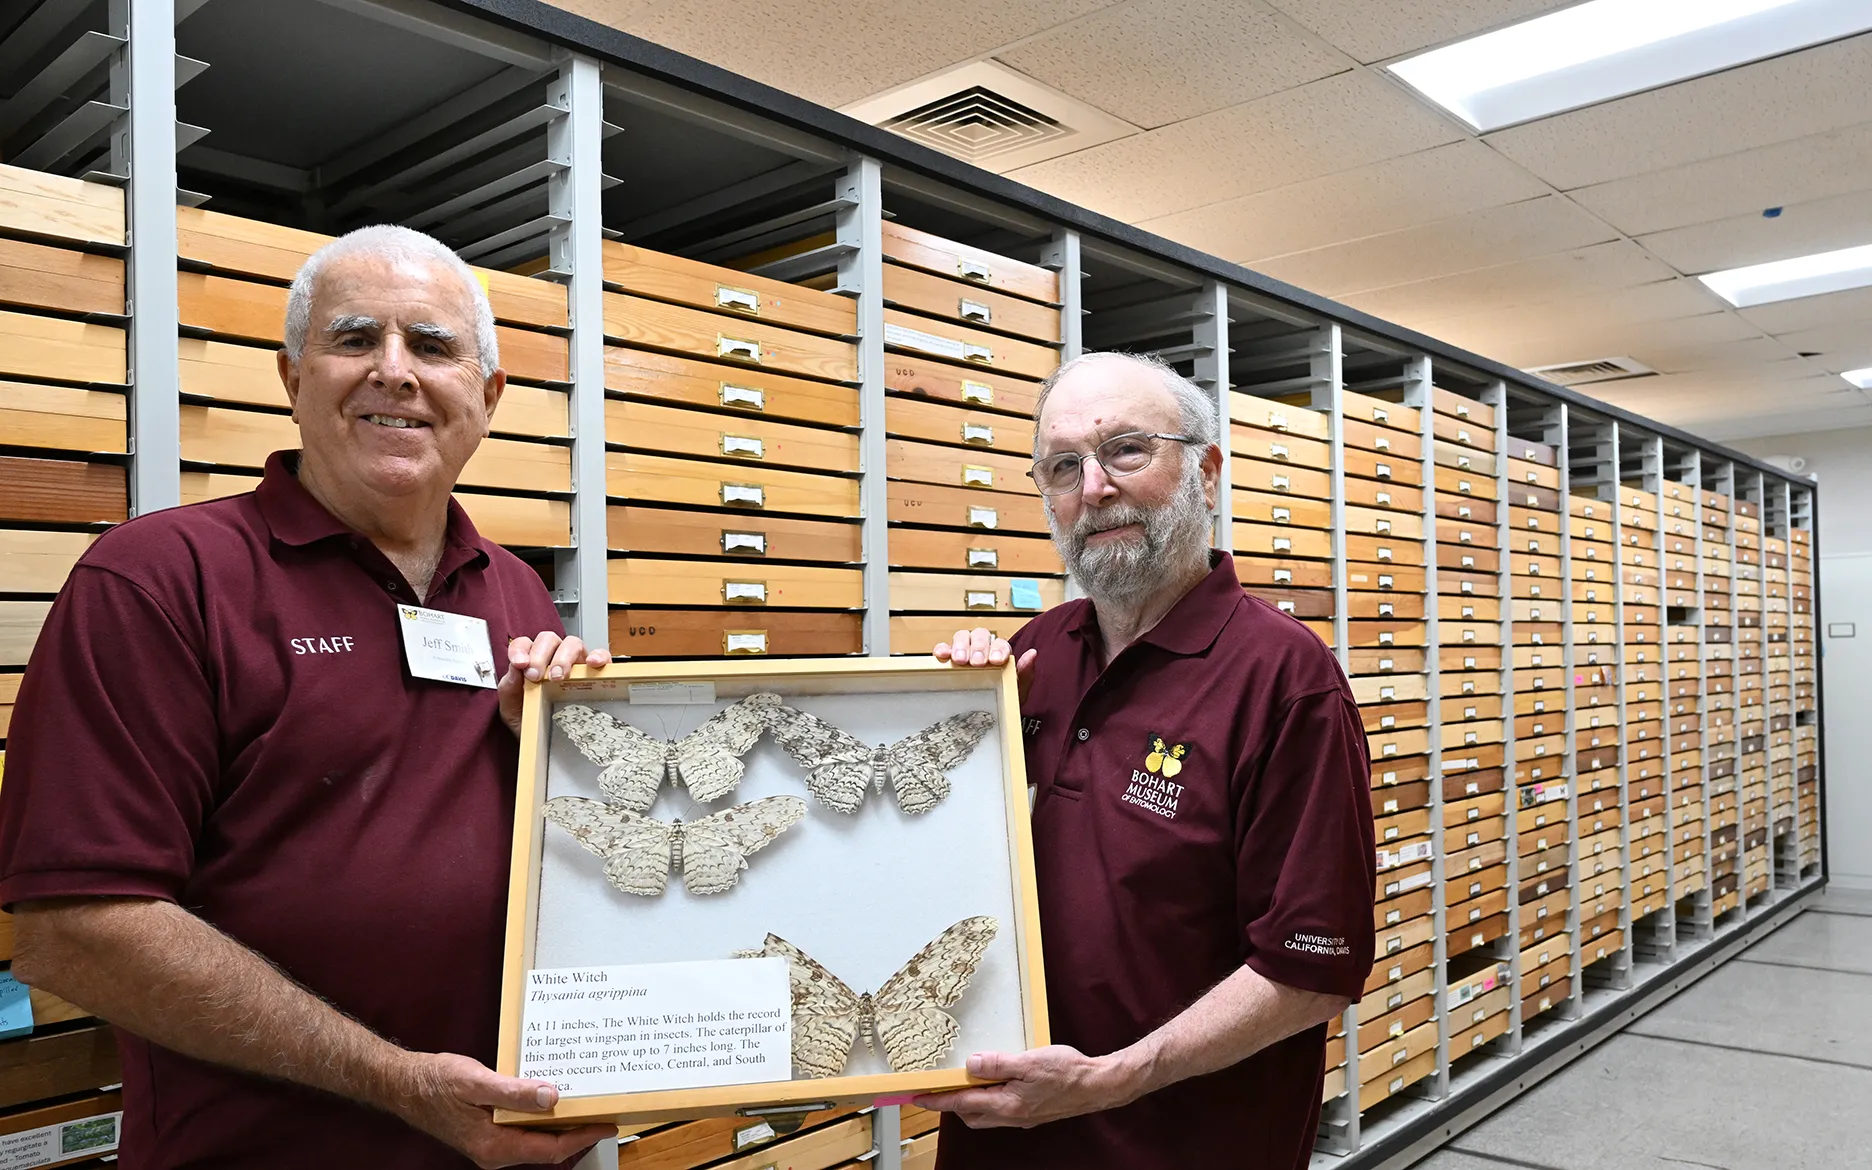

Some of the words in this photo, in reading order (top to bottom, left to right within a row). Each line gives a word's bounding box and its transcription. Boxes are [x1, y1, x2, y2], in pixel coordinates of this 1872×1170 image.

[629, 626, 656, 636] UCD
[291, 636, 355, 655] STAFF
[422, 636, 443, 650] Jeff
[444, 640, 474, 655] Smith
[1021, 717, 1042, 735] AFF
[1131, 769, 1185, 797] BOHART
[1126, 782, 1179, 811] MUSEUM
[1129, 796, 1177, 819] ENTOMOLOGY
[1294, 932, 1339, 946] UNIVERSITY
[1336, 946, 1350, 955] DAVIS
[532, 973, 568, 985] White
[572, 971, 608, 983] Witch
[530, 989, 585, 1004] Thysania
[588, 986, 648, 1002] agrippina
[527, 1021, 541, 1032] At
[545, 1020, 556, 1031] 11
[561, 1019, 599, 1030] inches,
[602, 1017, 624, 1028] The
[627, 1015, 659, 1027] White
[662, 1013, 694, 1025] Witch
[697, 1011, 726, 1023] holds
[728, 1010, 745, 1021] the
[748, 1008, 781, 1019] record
[526, 1036, 543, 1047] for
[545, 1035, 581, 1048] largest
[585, 1033, 637, 1046] wingspan
[640, 1030, 650, 1041] in
[653, 1029, 692, 1040] insects.
[696, 1026, 716, 1037] The
[719, 1023, 772, 1037] caterpillar
[774, 1021, 788, 1032] of
[525, 1051, 545, 1062] this
[548, 1049, 576, 1061] moth
[579, 1050, 598, 1059] can
[601, 1049, 630, 1061] grow
[632, 1047, 647, 1058] up
[649, 1046, 660, 1056] to
[663, 1044, 670, 1054] 7
[673, 1042, 707, 1054] inches
[710, 1041, 736, 1053] long.
[740, 1039, 760, 1049] The
[524, 1065, 564, 1079] species
[566, 1065, 603, 1075] occurs
[605, 1062, 616, 1073] in
[620, 1060, 664, 1072] Mexico,
[667, 1056, 710, 1070] Central,
[712, 1055, 732, 1066] and
[735, 1053, 766, 1065] South
[2, 1138, 19, 1146] have
[20, 1131, 52, 1142] excellent
[4, 1143, 42, 1154] regurgitate
[15, 1151, 41, 1160] Tomato
